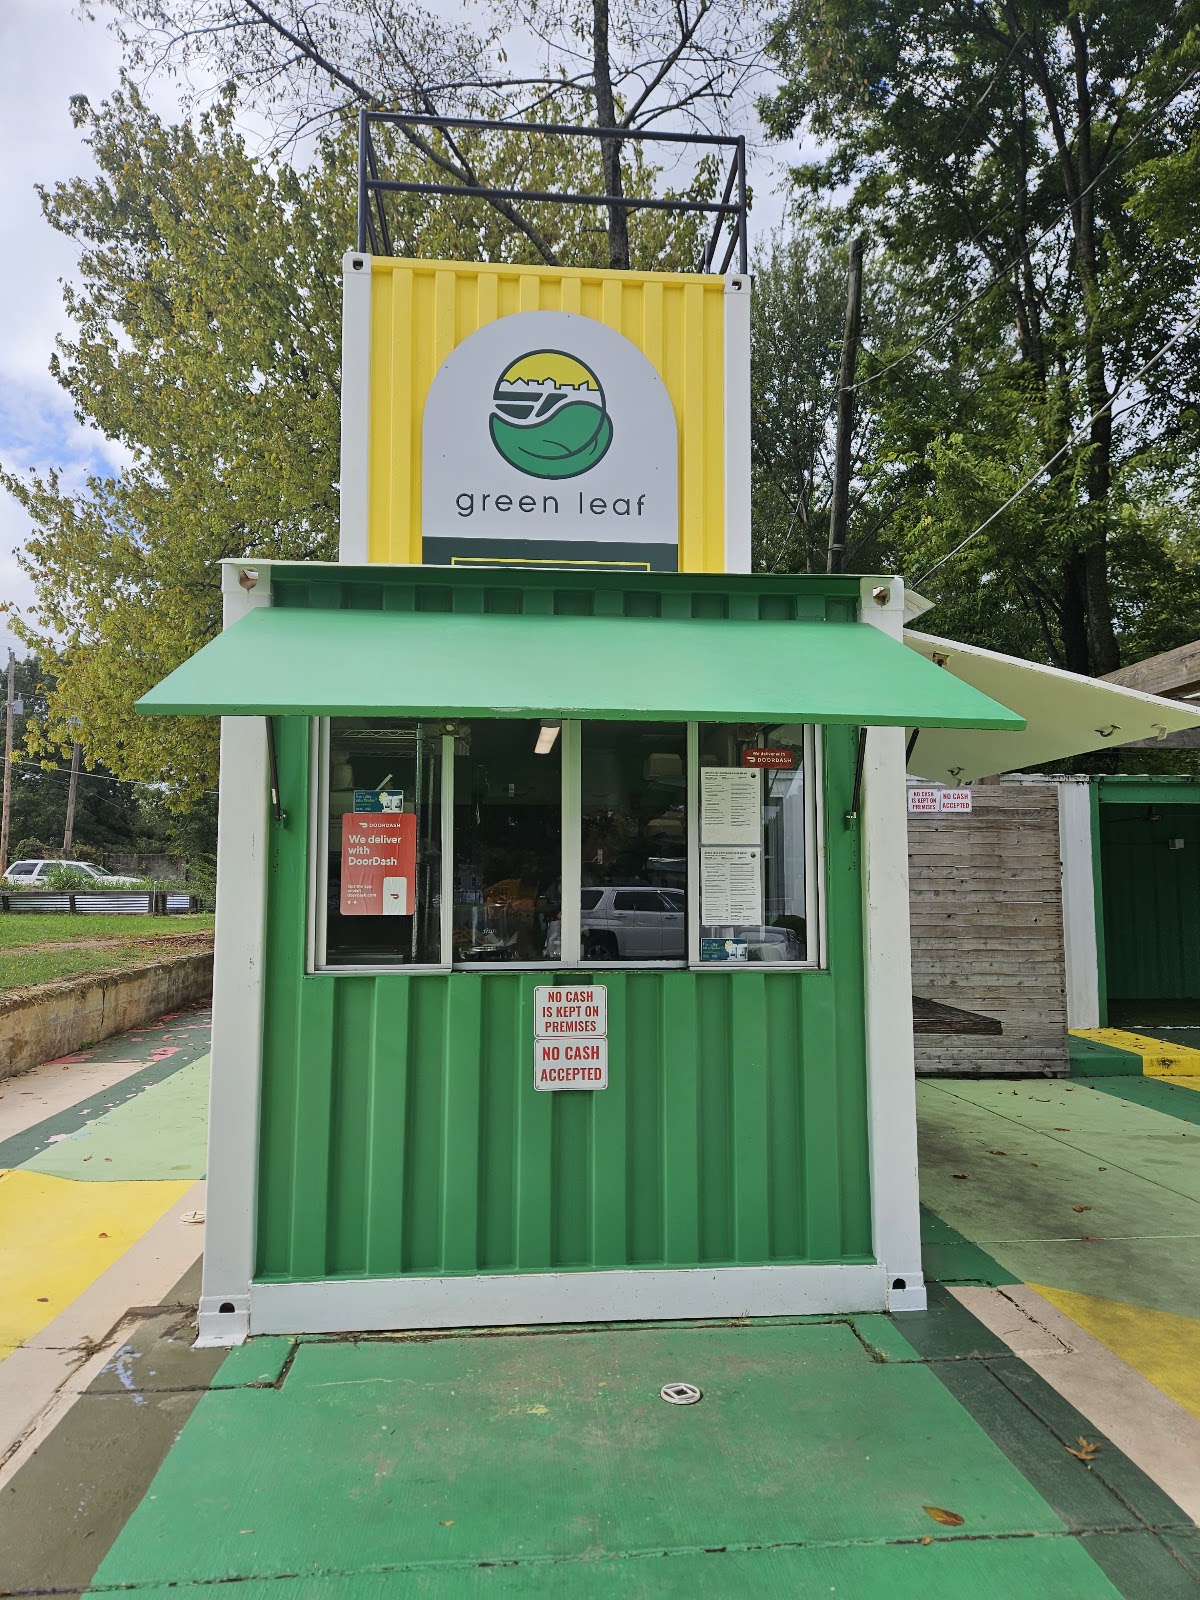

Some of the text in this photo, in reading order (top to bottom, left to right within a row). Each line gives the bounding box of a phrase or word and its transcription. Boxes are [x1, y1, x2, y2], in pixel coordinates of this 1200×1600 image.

[455, 491, 646, 518] green leaf
[348, 834, 402, 844] We deliver
[348, 845, 370, 855] with
[348, 856, 397, 866] DoorDash
[547, 990, 594, 1003] NO CASH
[542, 1005, 599, 1018] IS KEPT ON
[544, 1020, 597, 1033] PREMISES
[542, 1045, 600, 1061] NO CASH
[540, 1067, 602, 1082] ACCEPTED
